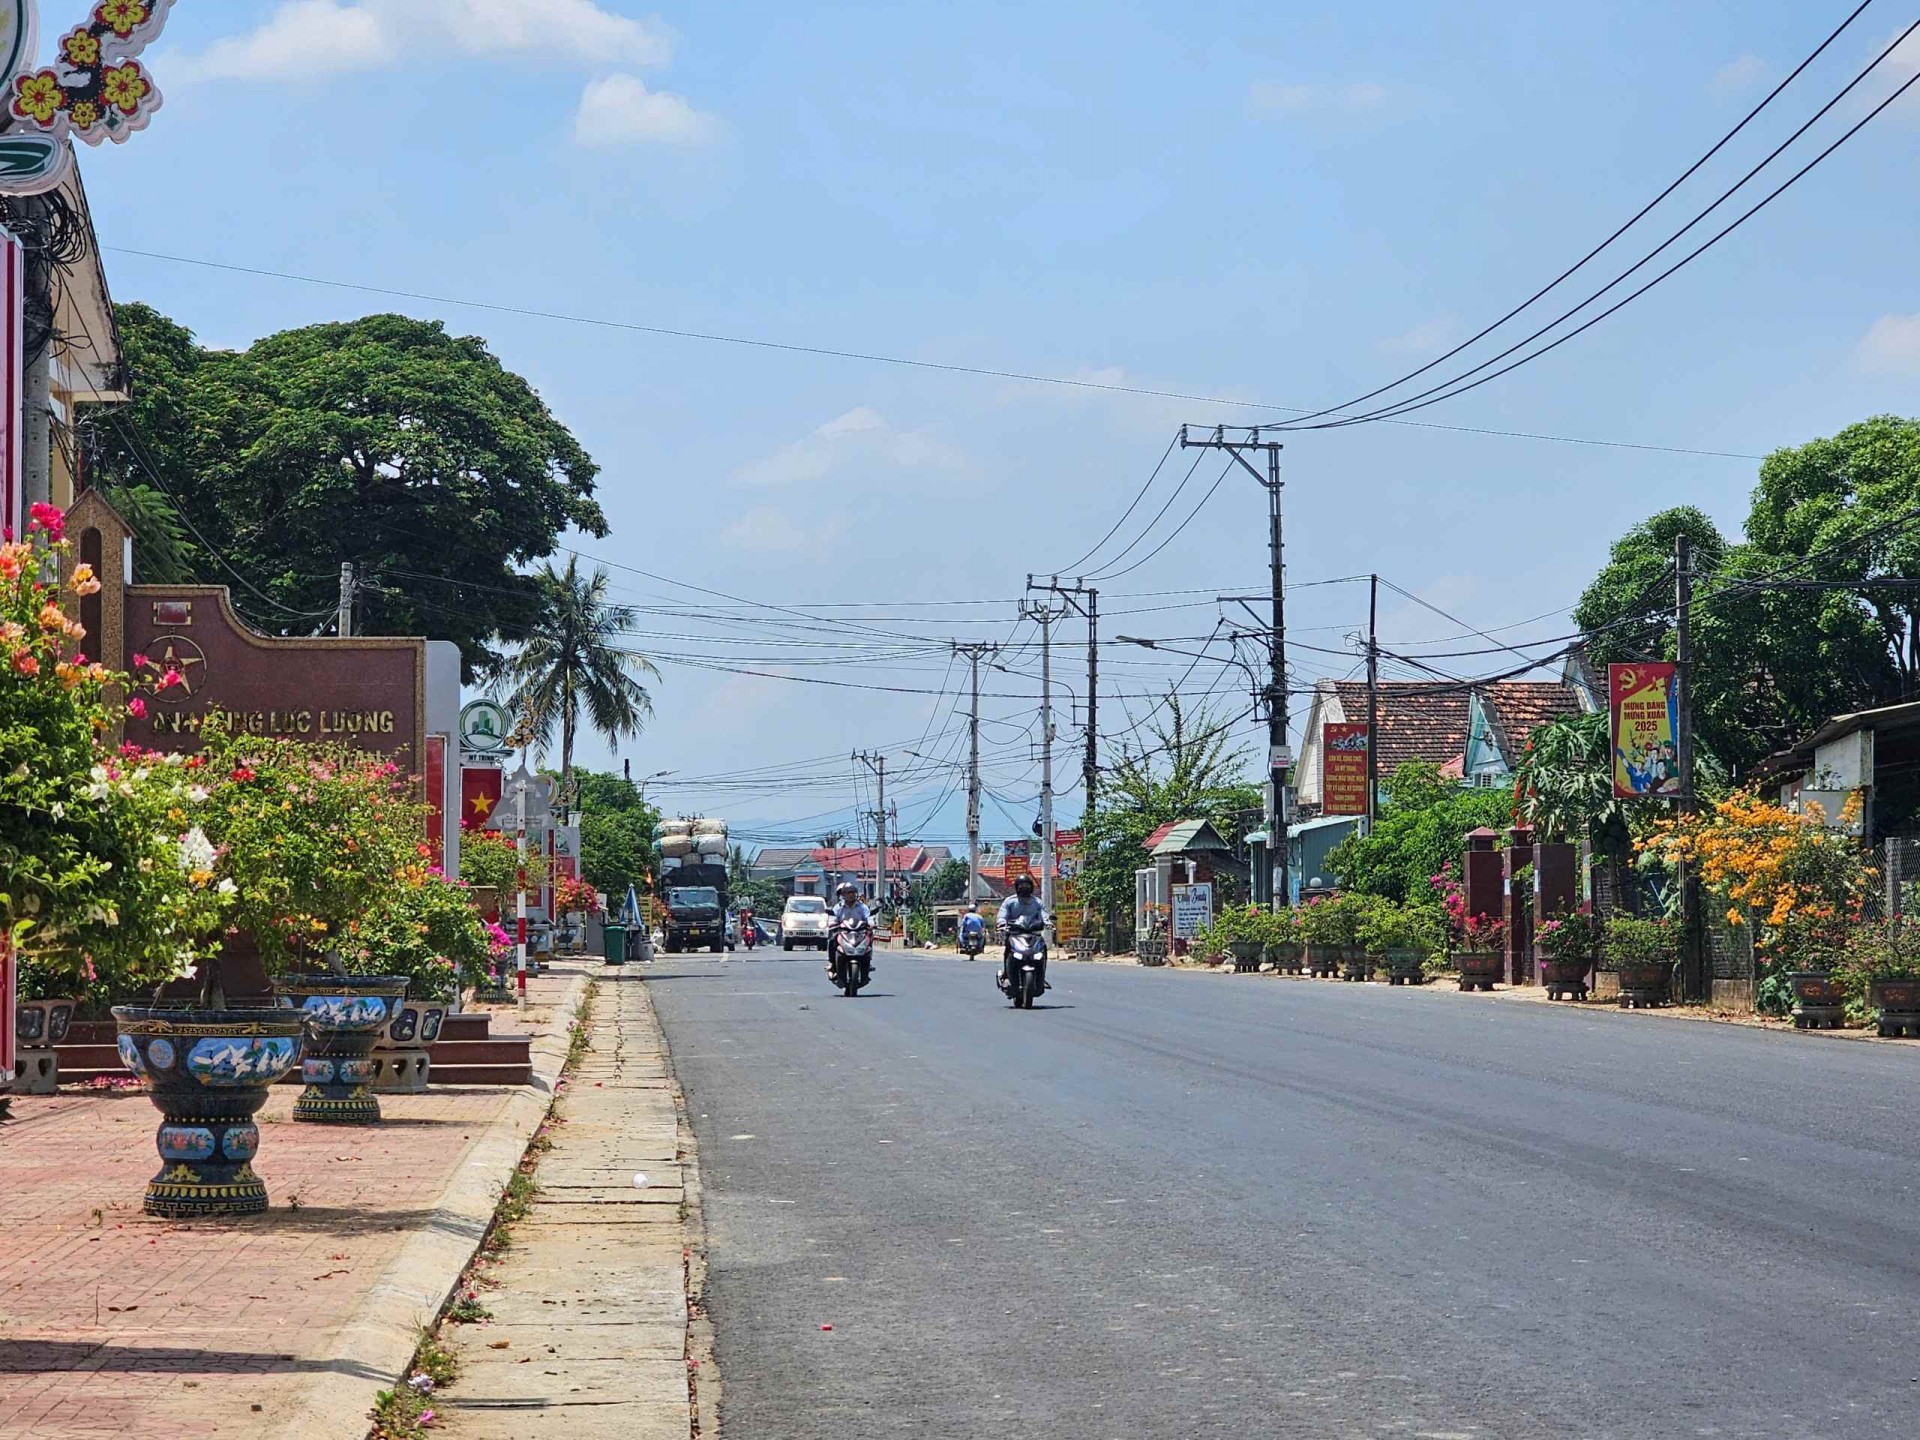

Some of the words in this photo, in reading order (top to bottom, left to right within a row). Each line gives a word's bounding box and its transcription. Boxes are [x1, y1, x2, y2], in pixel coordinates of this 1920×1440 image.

[1624, 701, 1644, 710] MỪNG
[1624, 711, 1645, 720] MỪNG
[204, 709, 263, 733] NG
[1635, 721, 1657, 731] 2025
